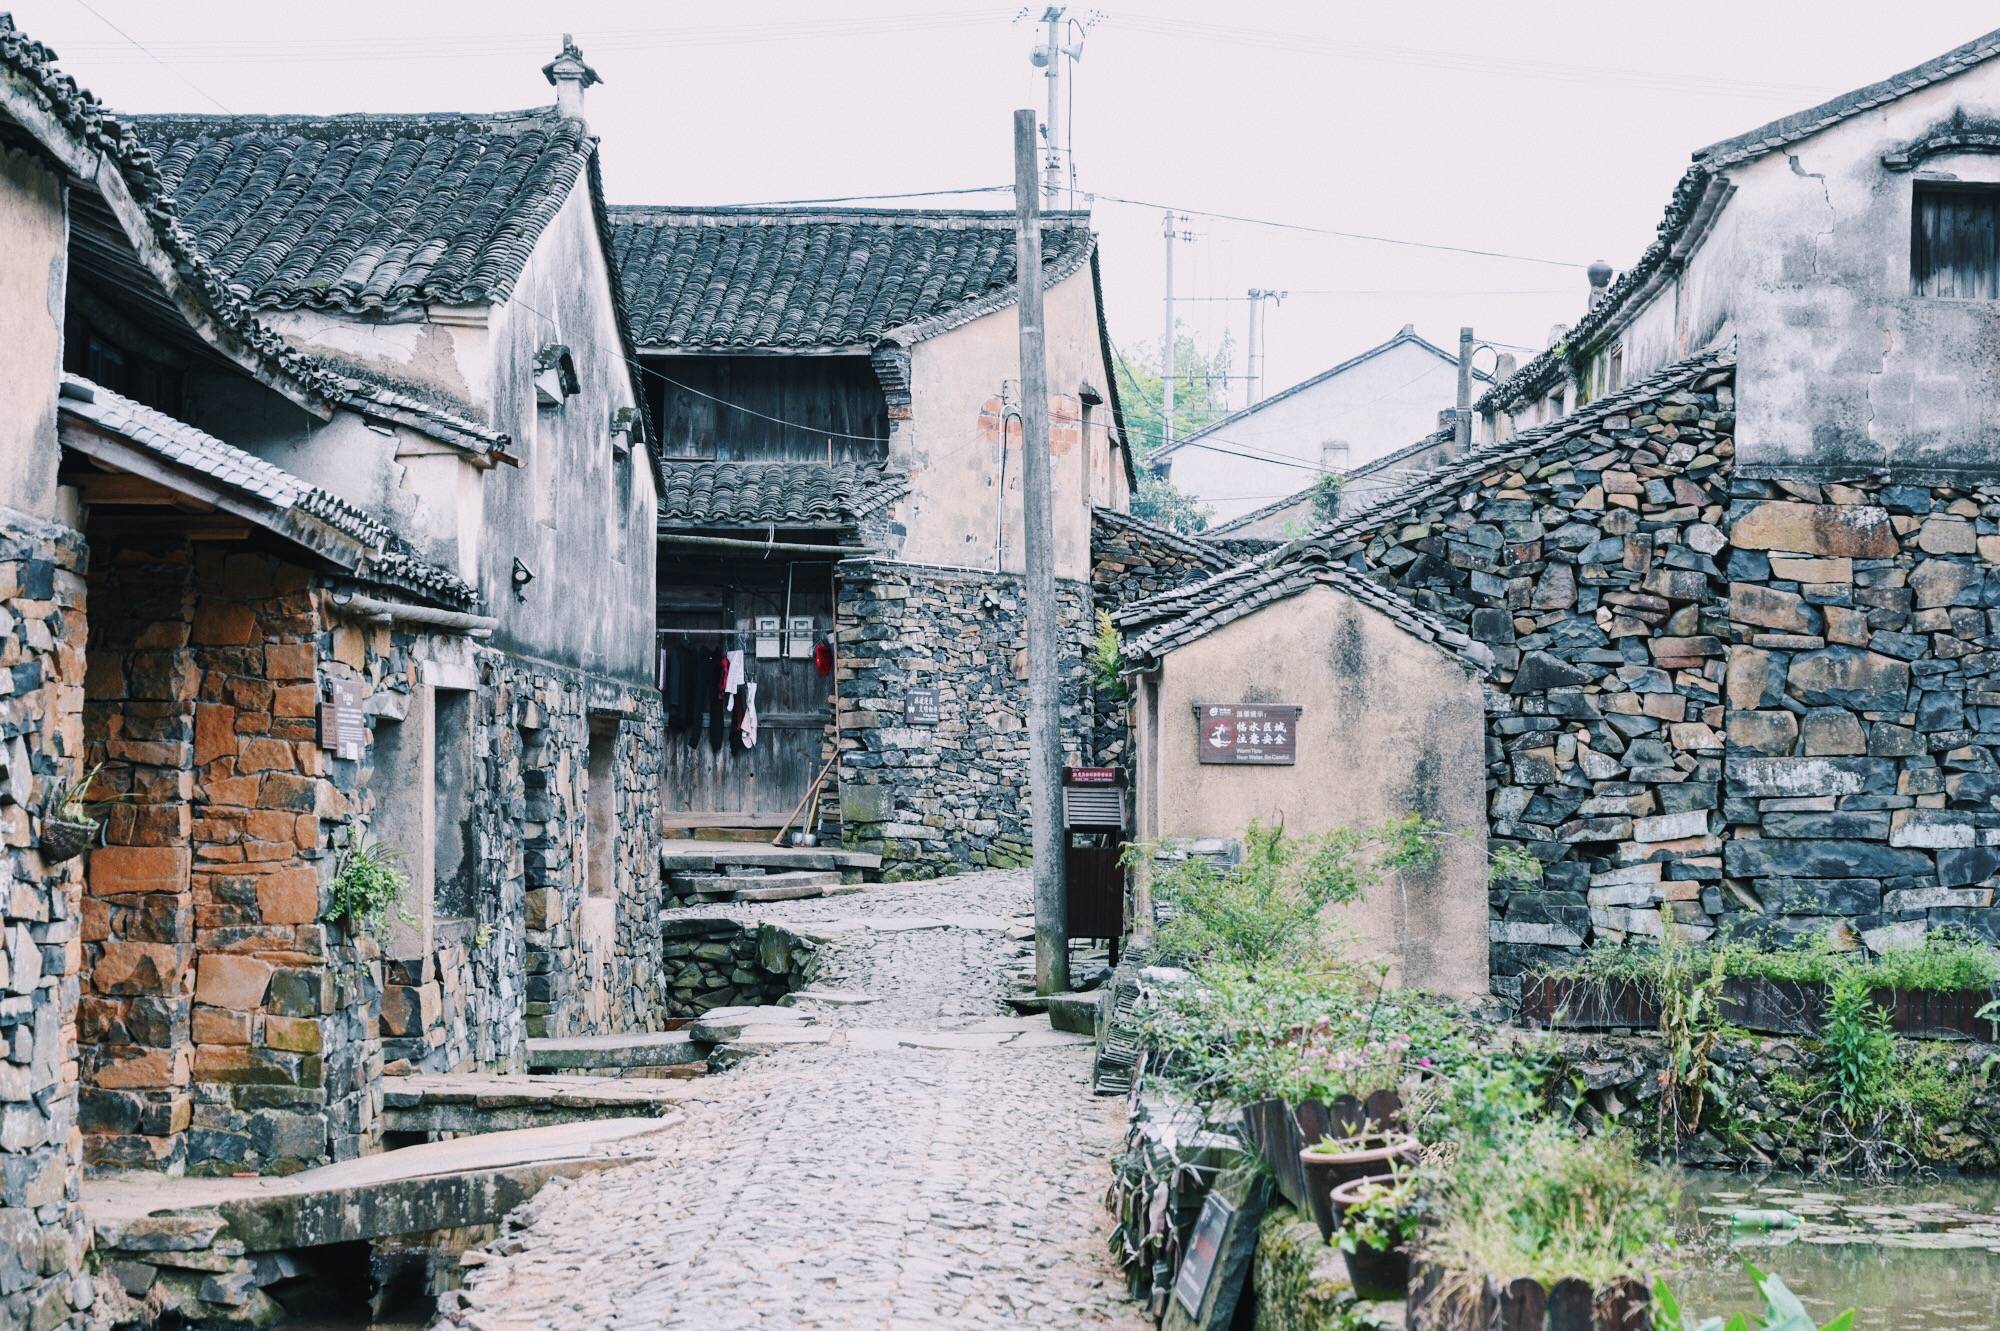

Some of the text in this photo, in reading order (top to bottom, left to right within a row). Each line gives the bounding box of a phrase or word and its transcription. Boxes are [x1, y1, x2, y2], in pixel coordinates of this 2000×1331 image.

[1236, 721, 1287, 733] 临水区域
[1236, 733, 1287, 745] 注意安全
